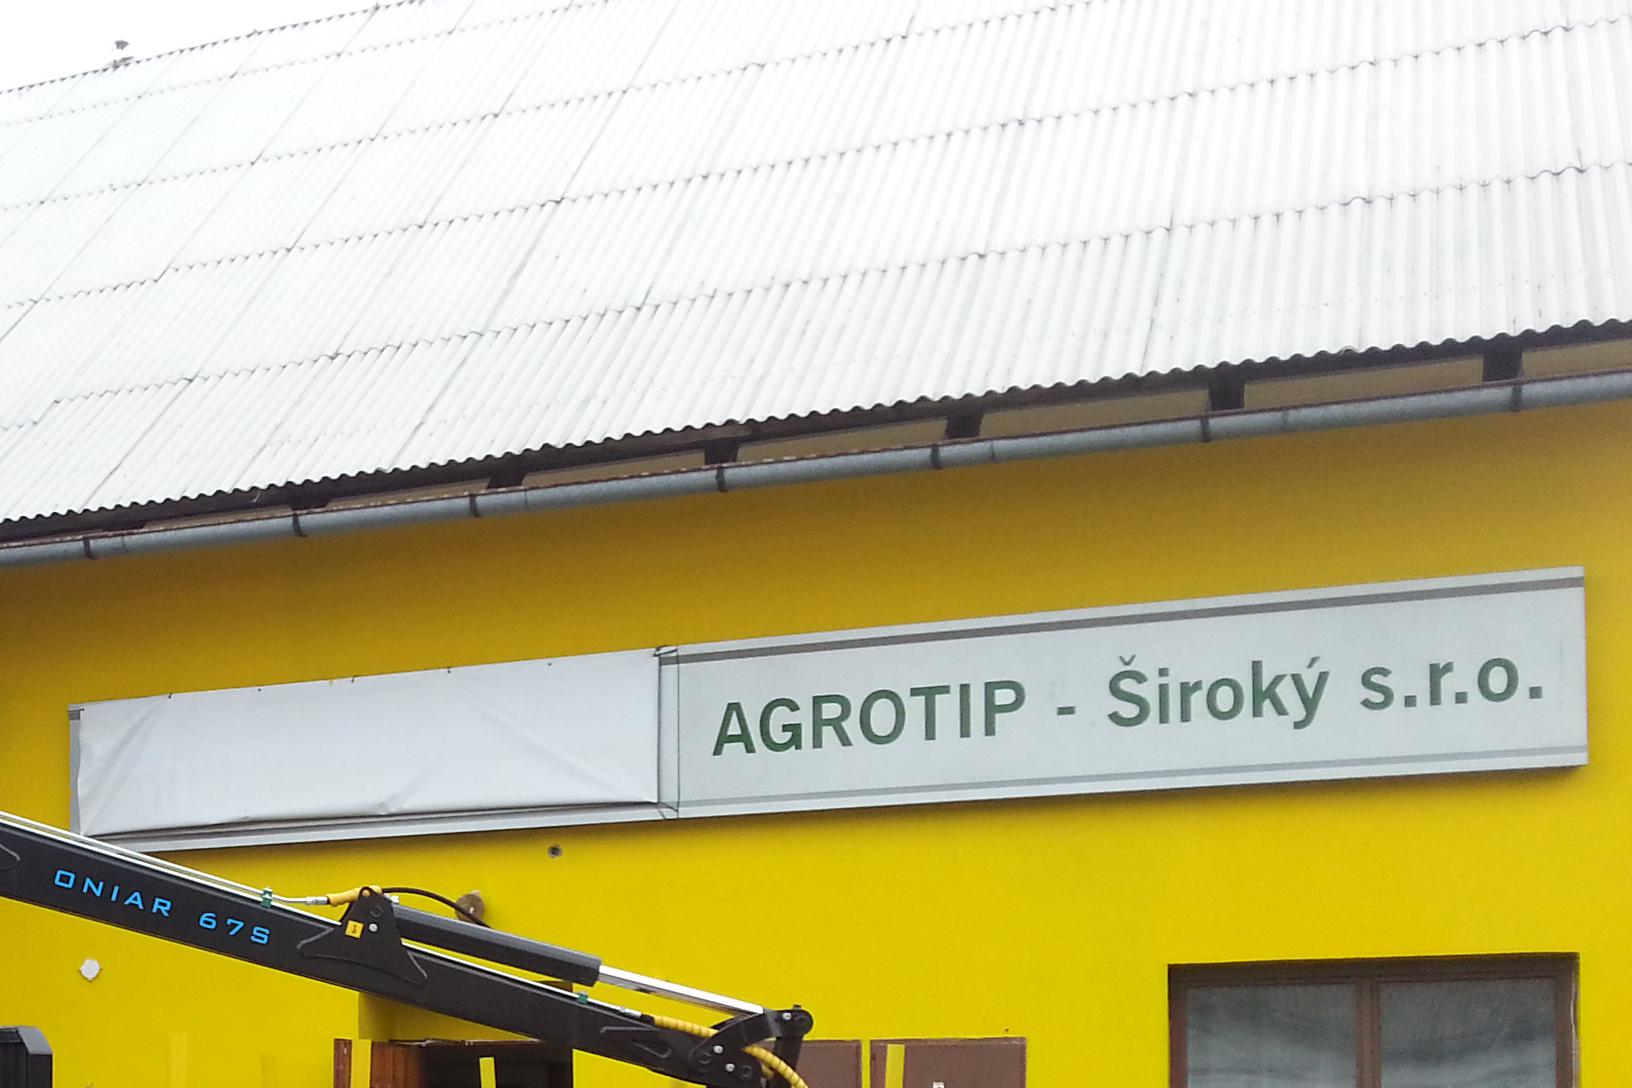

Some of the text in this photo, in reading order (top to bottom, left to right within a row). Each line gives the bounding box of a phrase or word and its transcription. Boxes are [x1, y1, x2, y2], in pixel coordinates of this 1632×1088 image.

[711, 655, 1546, 757] AGROTIP - Široký s.r.o.
[53, 869, 173, 918] ONIAR
